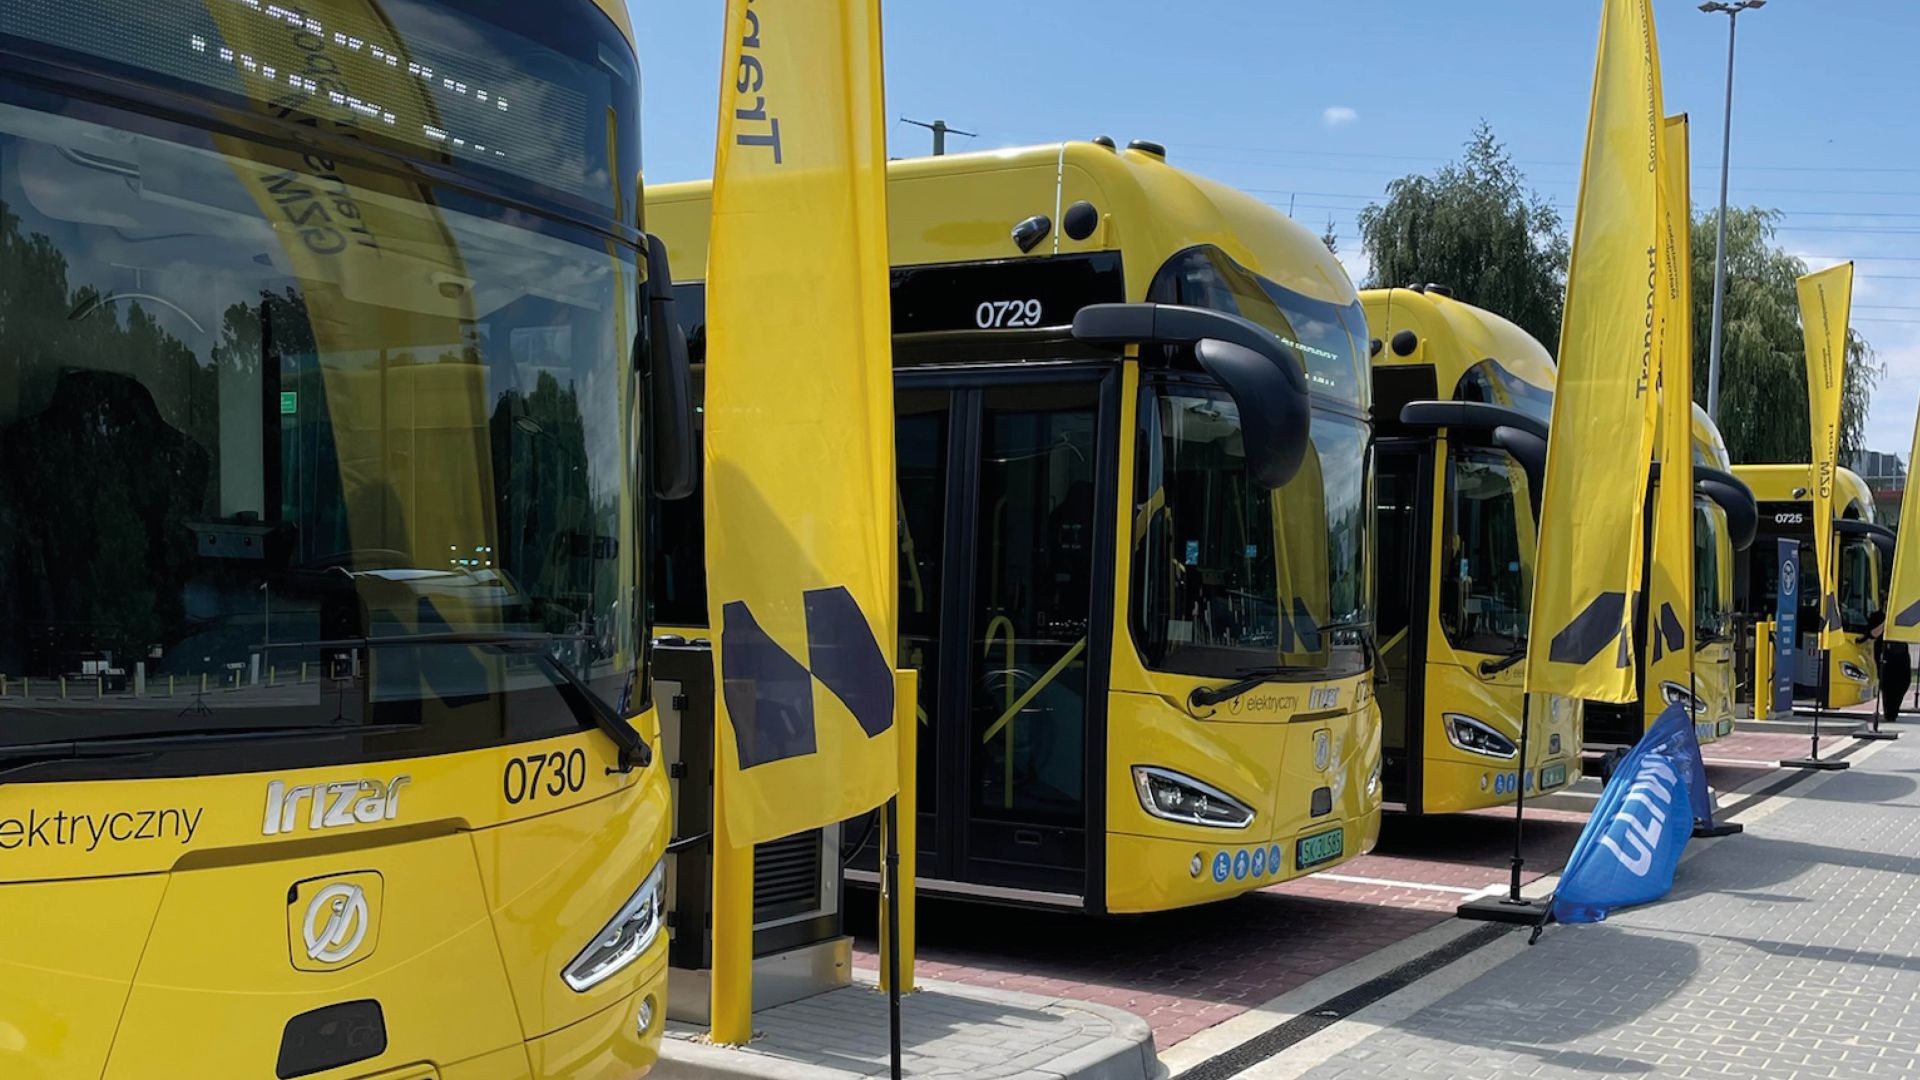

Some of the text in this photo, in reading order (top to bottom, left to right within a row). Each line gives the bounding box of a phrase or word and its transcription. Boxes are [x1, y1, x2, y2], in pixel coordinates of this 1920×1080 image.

[975, 299, 1042, 328] 0729
[1775, 513, 1802, 523] 0725
[1247, 694, 1299, 713] elektryczny
[502, 747, 586, 804] 0730
[262, 775, 411, 836] Irizar
[0, 806, 203, 852] ektryczny
